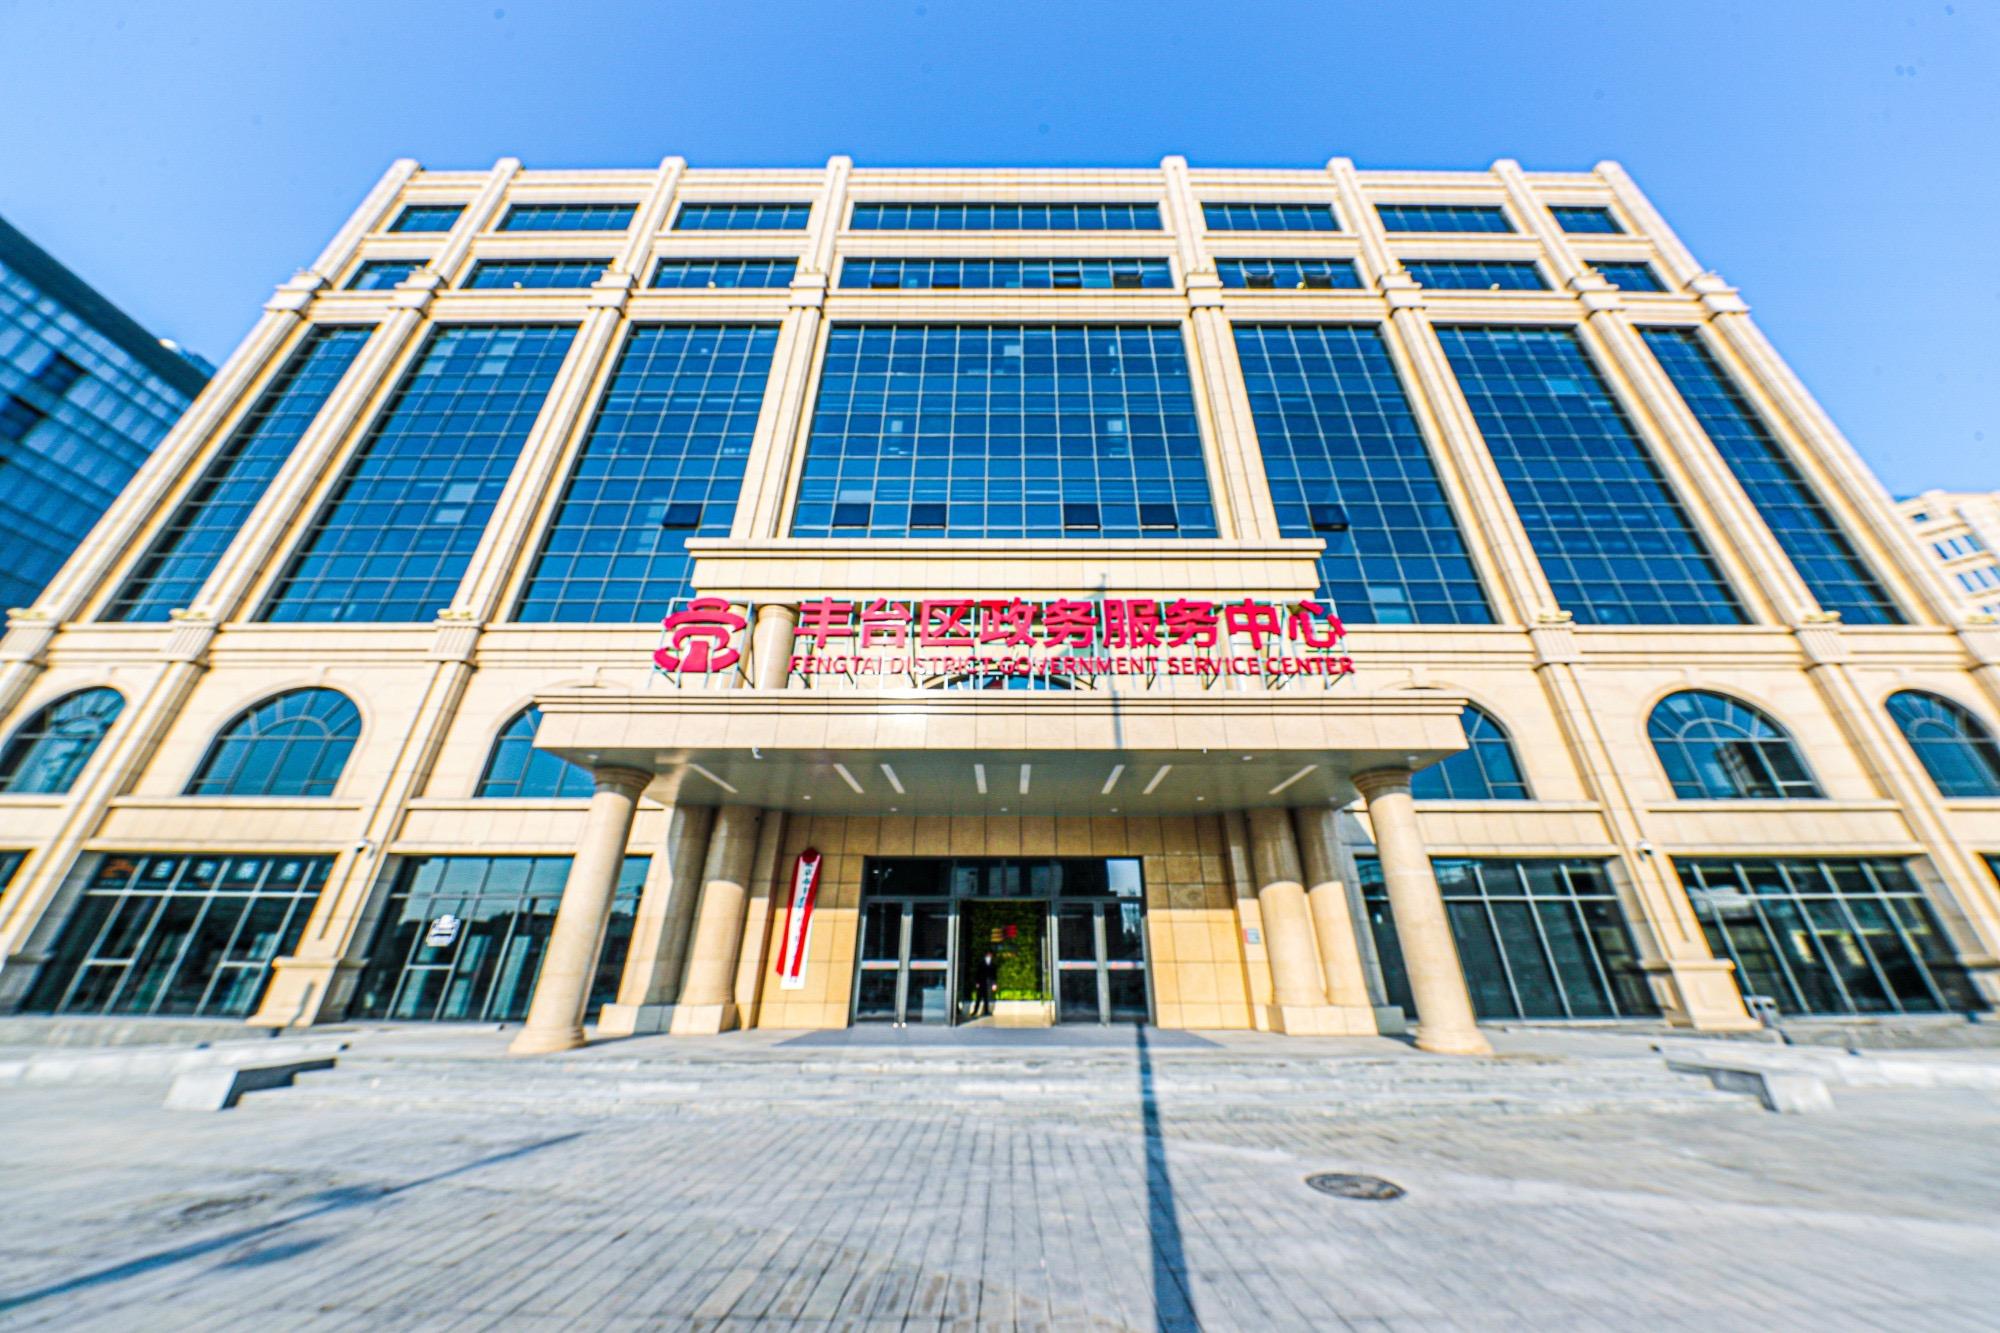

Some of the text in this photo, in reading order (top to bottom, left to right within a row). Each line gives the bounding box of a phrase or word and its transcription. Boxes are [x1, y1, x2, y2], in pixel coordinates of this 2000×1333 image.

[793, 597, 1347, 649] 丰台区政务服务中心
[788, 655, 1355, 676] FENGTAI DISTRICT GOVERNMENT SERVICE CENTER
